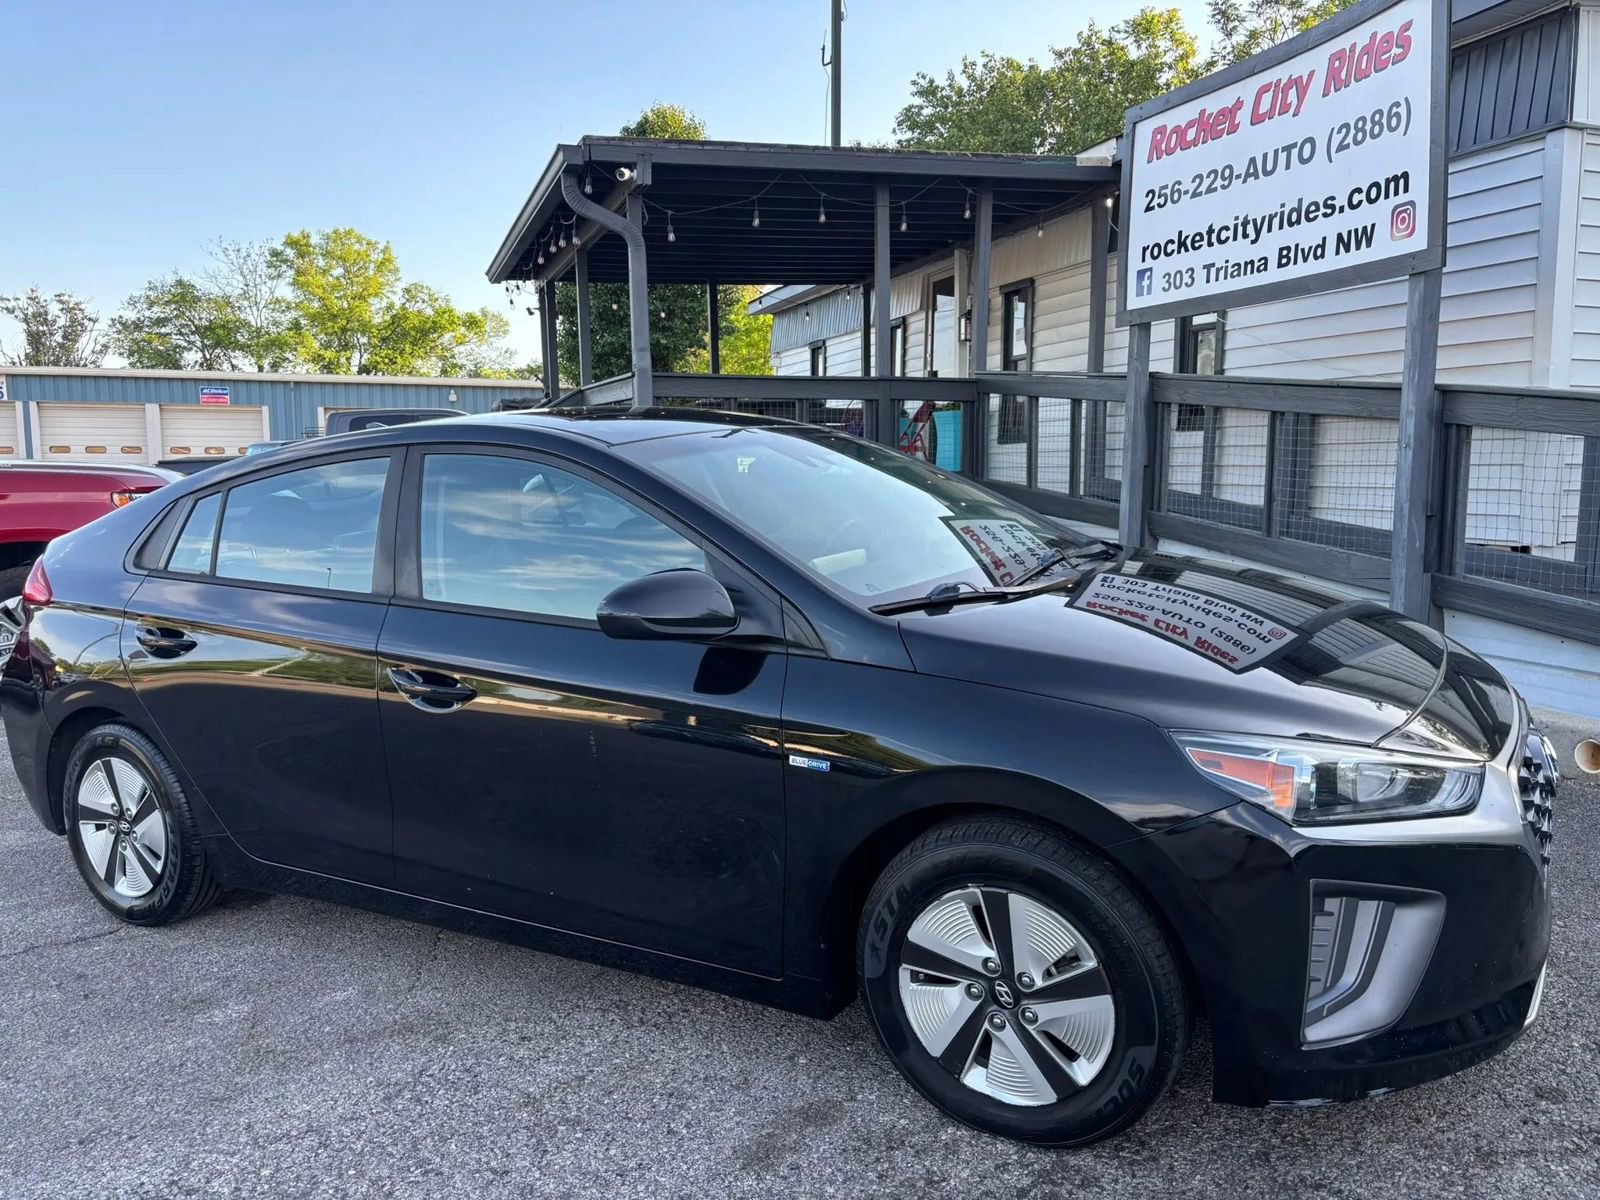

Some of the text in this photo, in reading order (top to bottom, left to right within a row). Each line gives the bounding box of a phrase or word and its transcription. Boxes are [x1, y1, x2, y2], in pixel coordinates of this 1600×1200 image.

[1147, 19, 1414, 164] Rocket City Rides
[1144, 96, 1412, 213] 256-229-AUTO (2886)
[1141, 170, 1410, 263] rocketcityrides.com
[1161, 223, 1377, 293] 303 Triana Blvd NW
[808, 760, 827, 770] DRIVE
